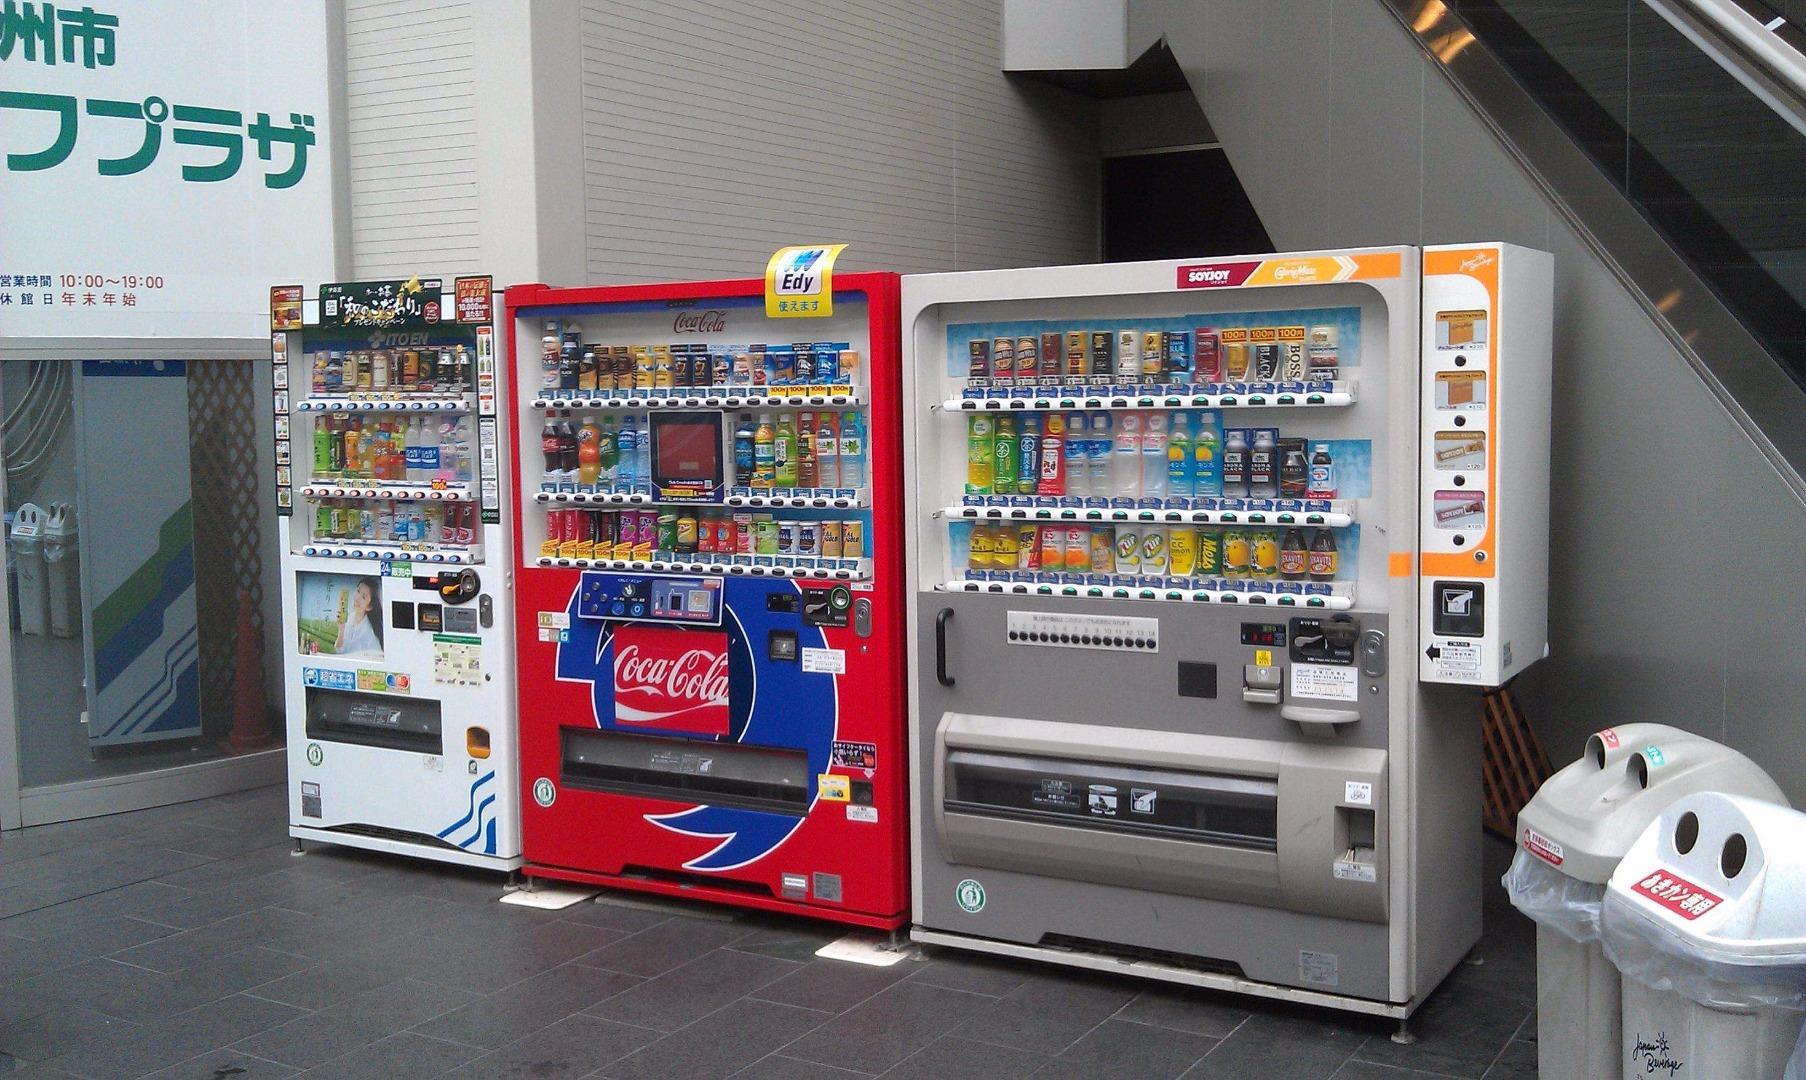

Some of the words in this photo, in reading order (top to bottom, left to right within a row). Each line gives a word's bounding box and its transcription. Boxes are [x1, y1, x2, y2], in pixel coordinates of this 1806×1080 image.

[0, 275, 52, 288] 営業時間
[781, 272, 814, 293] Edy
[1188, 269, 1231, 283] SOYJOY
[778, 300, 820, 313] 使えます
[1290, 345, 1301, 379] BOSS
[613, 644, 730, 702] Coca-Cola
